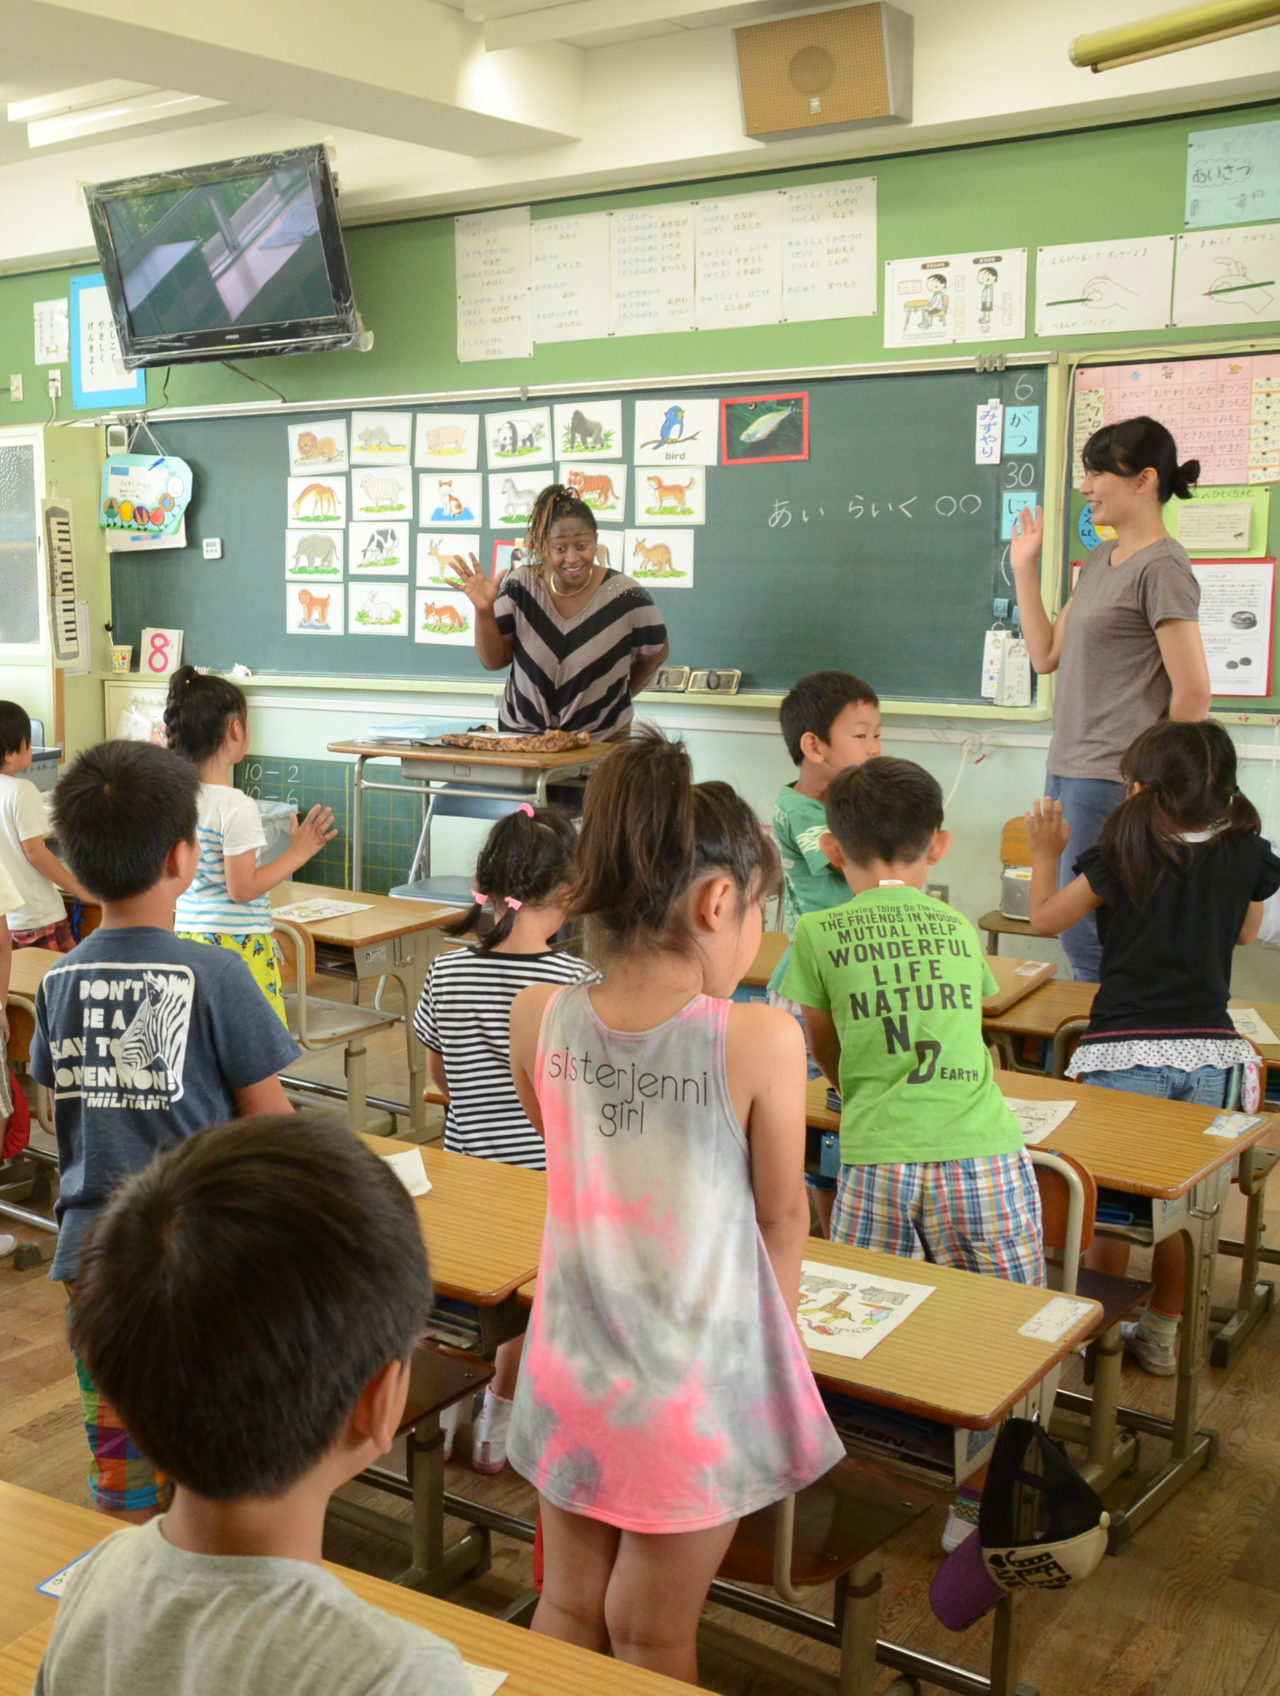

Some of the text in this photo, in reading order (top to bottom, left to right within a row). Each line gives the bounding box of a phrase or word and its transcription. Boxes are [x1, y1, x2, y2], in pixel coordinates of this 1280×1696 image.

[1192, 164, 1252, 184] あいさつ
[1014, 373, 1034, 400] 6
[980, 410, 998, 458] みずやり
[1010, 410, 1033, 448] がつ
[665, 452, 686, 460] bird
[1004, 461, 1035, 488] 30
[768, 498, 824, 528] あい
[848, 495, 918, 519] らいく
[148, 632, 170, 673] 8
[819, 918, 845, 932] THE
[847, 913, 904, 927] FRIENDS
[907, 912, 922, 923] IN
[828, 911, 844, 919] The
[846, 907, 873, 916] Living
[876, 905, 900, 914] Thing
[904, 904, 915, 912] On
[838, 922, 957, 945] MUTUAL HELP
[828, 938, 972, 968] WONDERFUL
[872, 959, 943, 987] LIFE
[80, 979, 144, 1001] DON'T
[849, 983, 974, 1021] NATURE
[83, 1008, 127, 1030] BE A
[548, 1047, 707, 1106] sisterjenni
[940, 1067, 979, 1082] EARTH
[599, 1101, 644, 1137] girl
